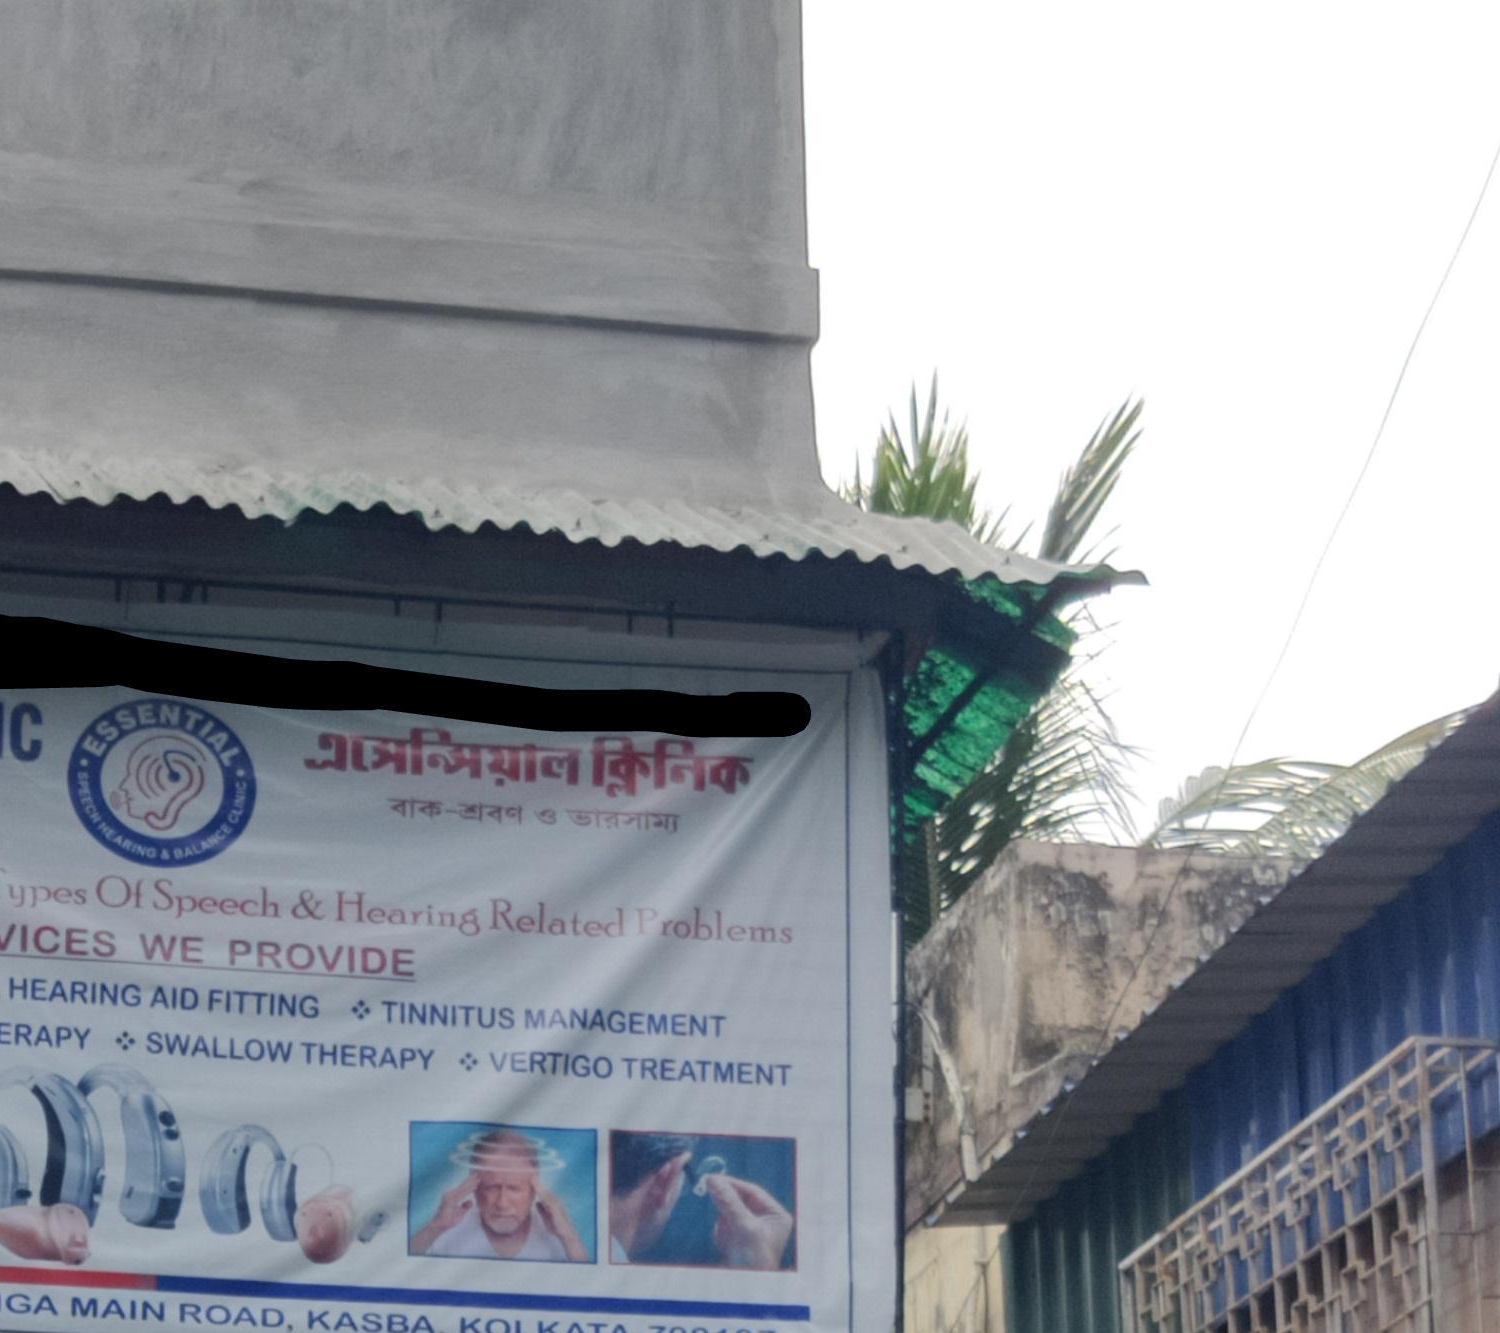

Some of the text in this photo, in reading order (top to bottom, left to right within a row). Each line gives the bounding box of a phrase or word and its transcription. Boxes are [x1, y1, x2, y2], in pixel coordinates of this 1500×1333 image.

[82, 703, 240, 767] ESSENTIAL
[592, 736, 754, 798] ক্লিনিক
[77, 771, 248, 861] SPEECH HEARING & BALANCE CLINIC
[534, 807, 557, 826] ও
[94, 875, 148, 911] Of
[152, 878, 281, 920] Speech
[291, 890, 322, 920] &
[336, 891, 480, 937] Hearing
[489, 899, 626, 939] Related
[636, 908, 793, 946] Problems
[140, 933, 204, 964] WE
[229, 939, 416, 977] PROVIDE
[8, 977, 143, 1009] HEARING
[150, 986, 200, 1013] AID
[207, 989, 320, 1019] FITTING
[381, 1001, 516, 1030] TINNITUS
[524, 1007, 726, 1037] MANAGEMENT
[146, 1032, 293, 1065] SWALLOW
[301, 1043, 435, 1073] THERAPY
[489, 1051, 613, 1081] VERTIGO
[622, 1057, 792, 1087] TREATMENT
[70, 1297, 166, 1324] MAIN
